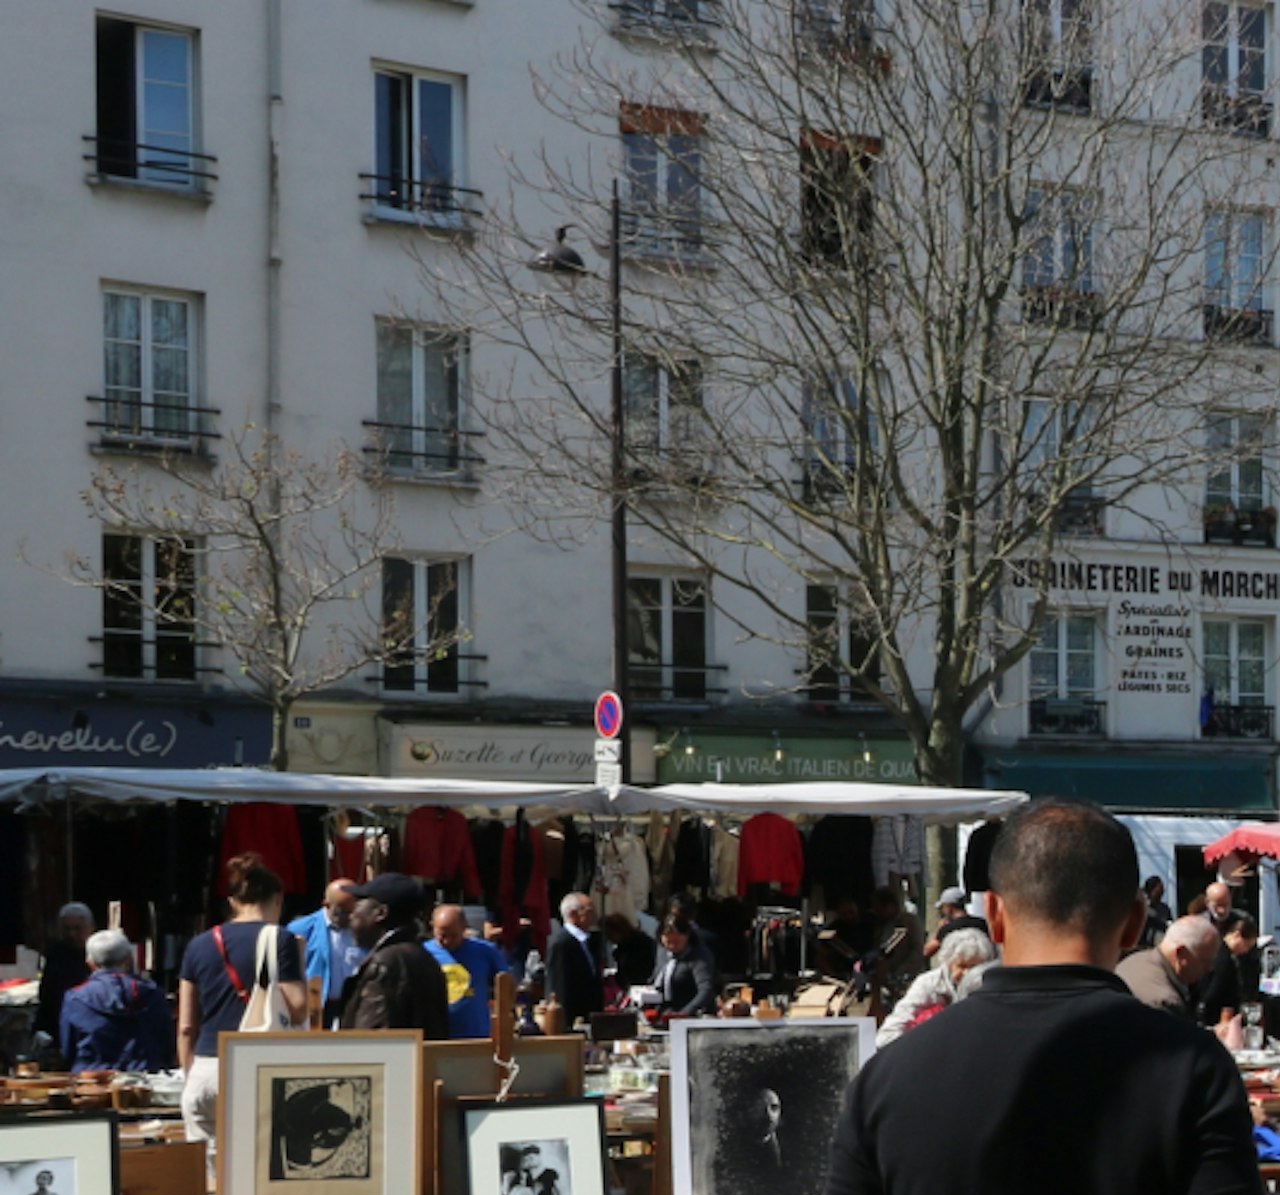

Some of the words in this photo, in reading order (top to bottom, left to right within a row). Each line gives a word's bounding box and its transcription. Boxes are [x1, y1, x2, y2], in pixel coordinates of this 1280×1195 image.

[1168, 571, 1192, 592] DU
[1125, 645, 1184, 658] GRAINES
[672, 755, 700, 774] VIN
[707, 756, 730, 776] EN
[736, 757, 783, 777] VRAC
[787, 757, 849, 777] ITALIEN
[854, 757, 875, 779] DE
